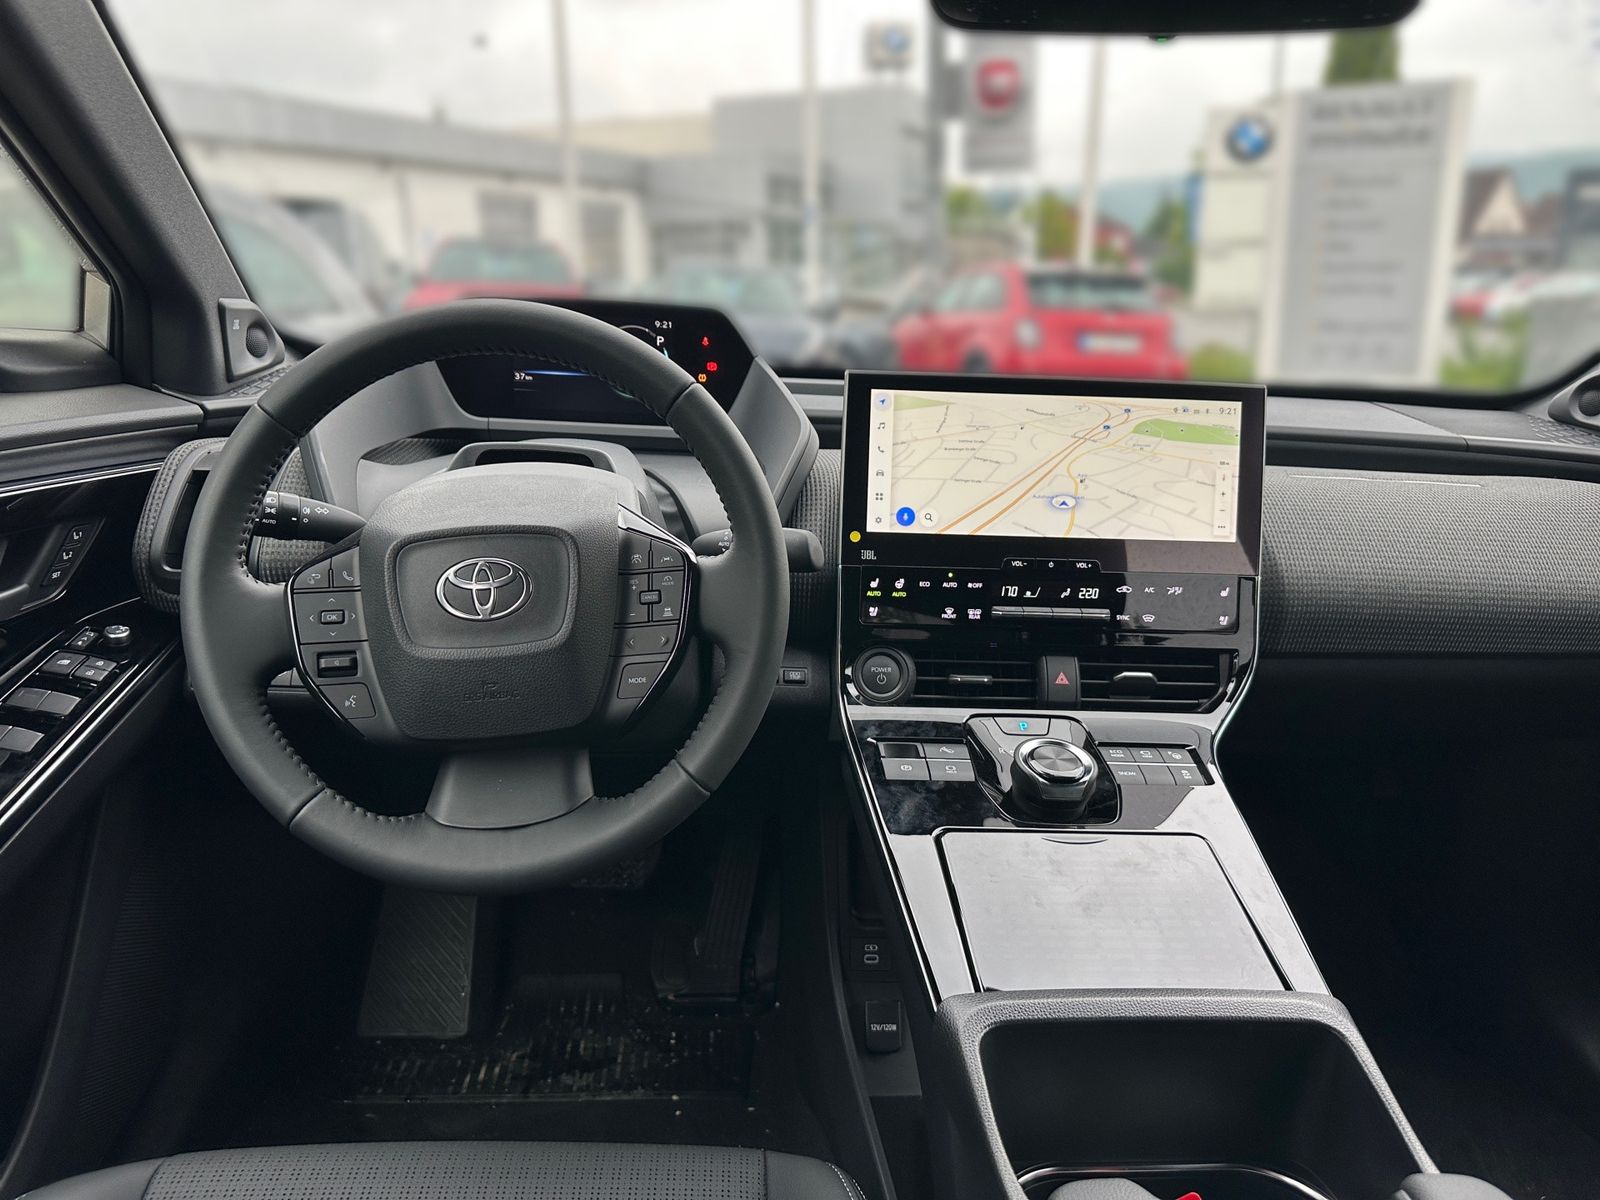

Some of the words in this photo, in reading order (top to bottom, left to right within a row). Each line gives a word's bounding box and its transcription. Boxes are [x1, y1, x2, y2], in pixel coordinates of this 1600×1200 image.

[654, 320, 673, 329] 9:21
[656, 335, 665, 347] P
[861, 549, 877, 560] JBL
[51, 570, 61, 579] SET
[326, 613, 339, 621] OK
[627, 676, 647, 685] MODE
[1019, 721, 1028, 731] P
[870, 1023, 897, 1031] 12V/120W
